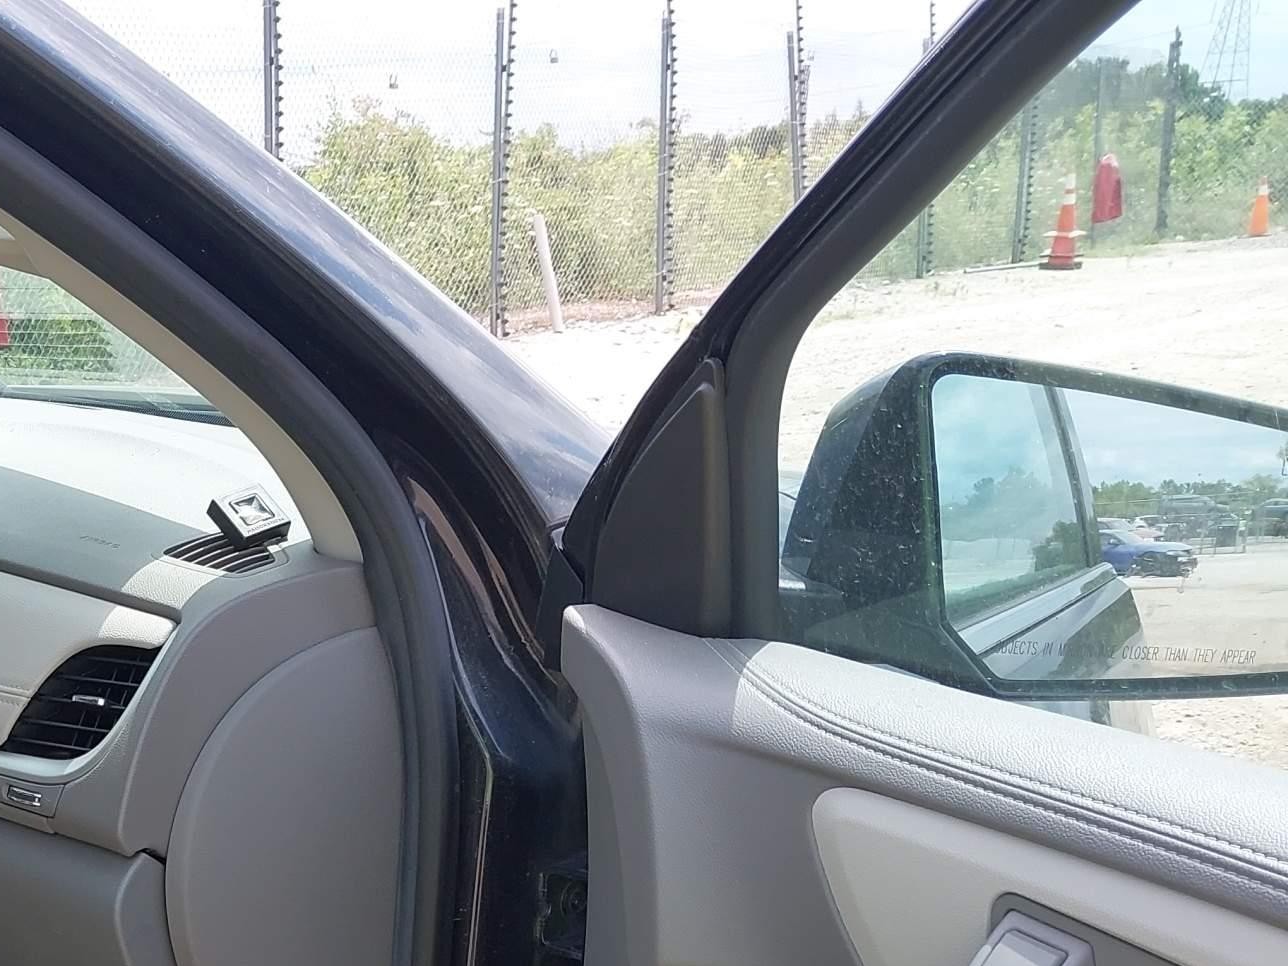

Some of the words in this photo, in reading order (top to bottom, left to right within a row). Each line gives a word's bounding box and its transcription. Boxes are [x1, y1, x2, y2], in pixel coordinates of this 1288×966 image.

[997, 639, 1039, 656] BJECTS
[1121, 645, 1159, 661] CLOSER
[1165, 647, 1189, 661] THAN
[1193, 648, 1217, 663] THEY
[1220, 649, 1257, 665] APPEAR
